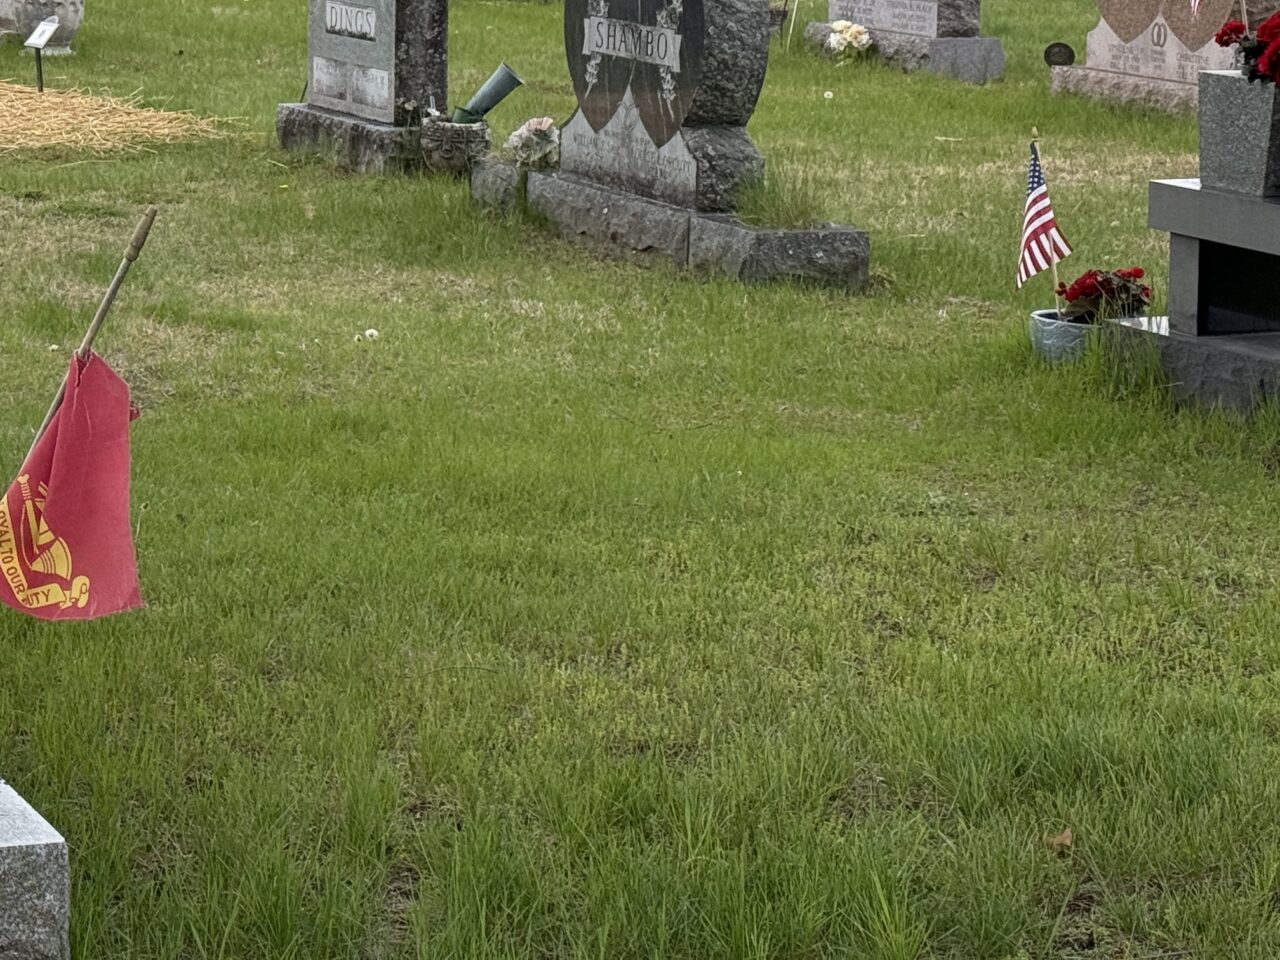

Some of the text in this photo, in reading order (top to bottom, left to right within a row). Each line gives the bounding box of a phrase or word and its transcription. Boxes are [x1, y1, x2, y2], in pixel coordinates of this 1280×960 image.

[329, 6, 373, 35] DINGS
[595, 21, 669, 60] SHAMBO
[1, 548, 14, 565] TO
[6, 565, 26, 596] OUR
